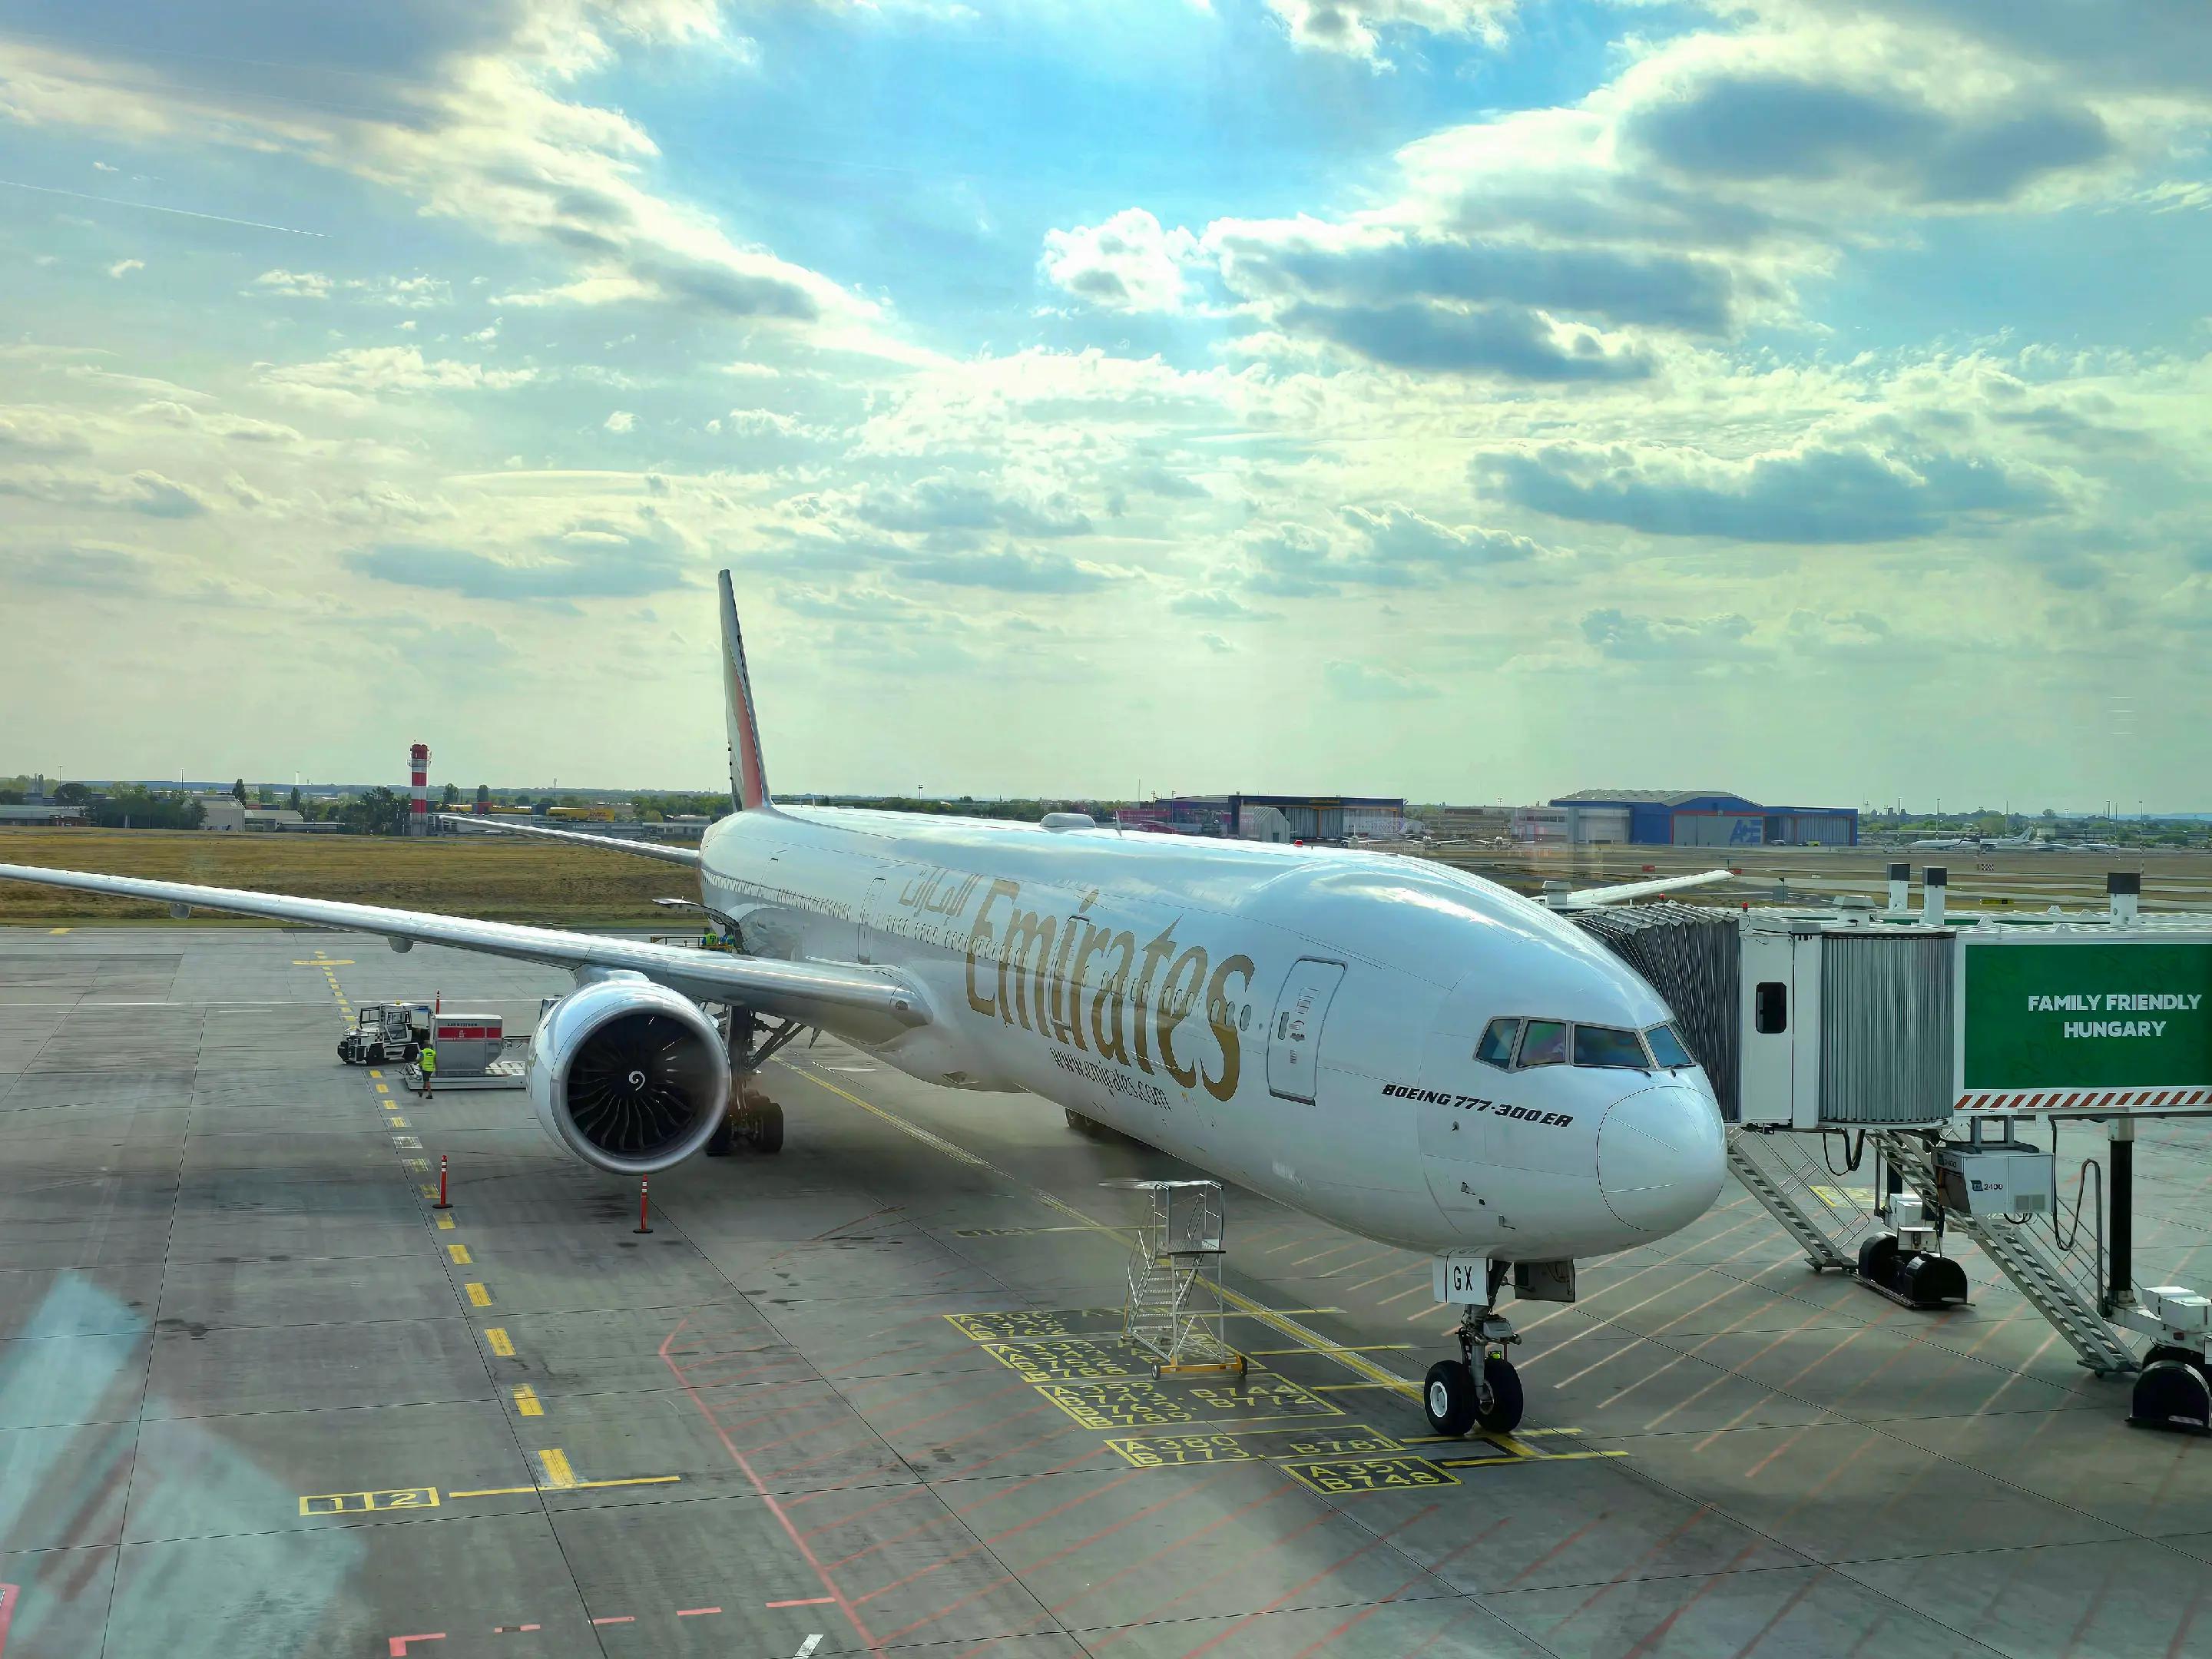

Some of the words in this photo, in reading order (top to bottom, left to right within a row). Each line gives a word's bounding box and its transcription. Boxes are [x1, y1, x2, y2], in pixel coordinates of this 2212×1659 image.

[965, 879, 1256, 1102] Emirates
[2028, 995, 2101, 1011] FAMILY
[2106, 994, 2202, 1011] FRIENDLY
[2064, 1021, 2167, 1038] HUNGARY
[1049, 1047, 1172, 1112] www.emirates.com
[1382, 1083, 1452, 1106] BOEING
[1453, 1265, 1473, 1291] GX
[1054, 1383, 1153, 1396] A359
[1083, 1412, 1192, 1427] B789
[1126, 1435, 1238, 1452] A380
[1310, 1460, 1412, 1478] A351
[1318, 1472, 1439, 1490] B748
